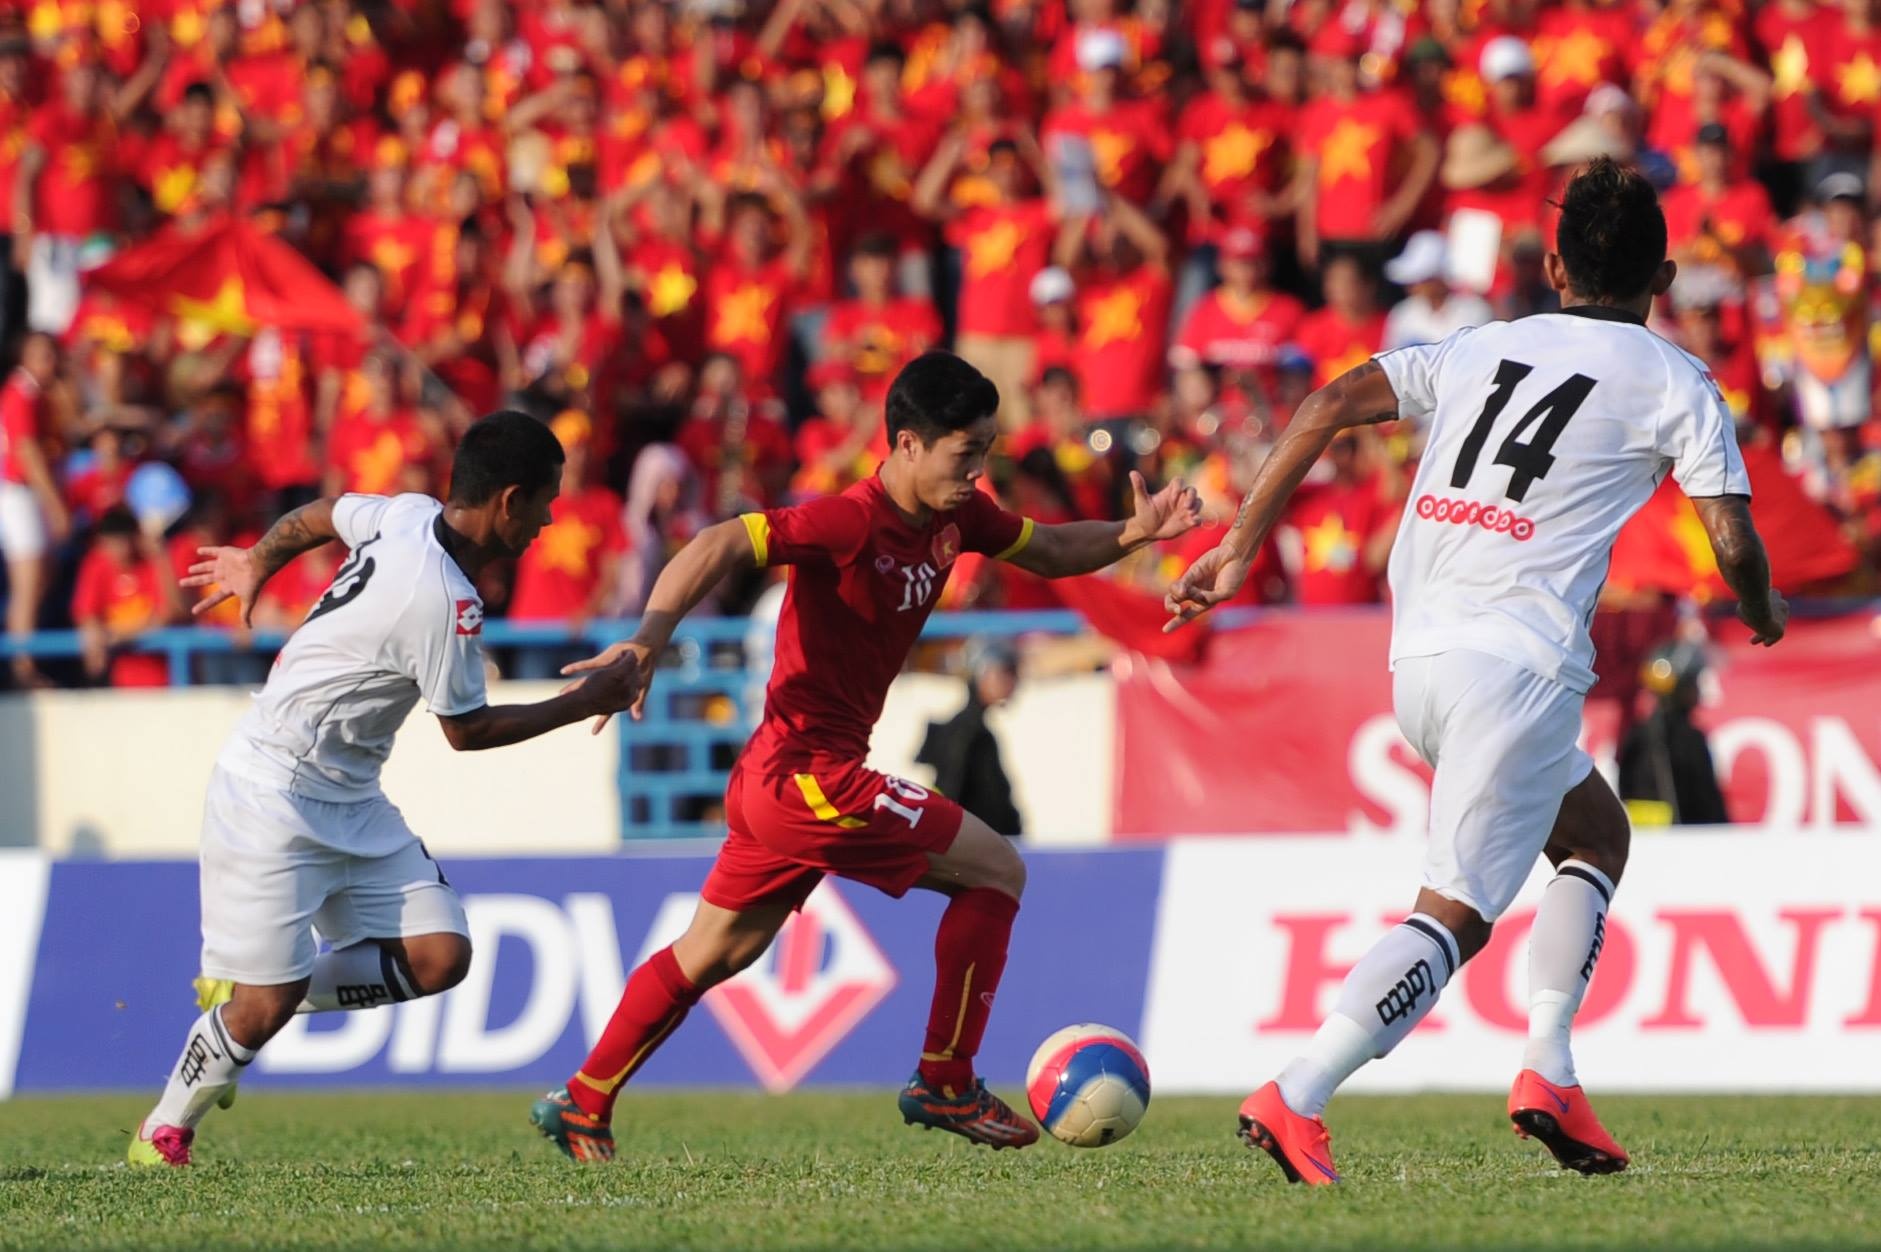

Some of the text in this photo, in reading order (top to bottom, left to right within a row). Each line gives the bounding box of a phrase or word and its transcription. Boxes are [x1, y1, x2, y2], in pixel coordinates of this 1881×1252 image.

[1450, 358, 1598, 503] 14
[1416, 494, 1535, 541] ooredoo
[897, 562, 936, 612] 10
[874, 775, 929, 829] 10
[1256, 906, 1881, 1033] HON
